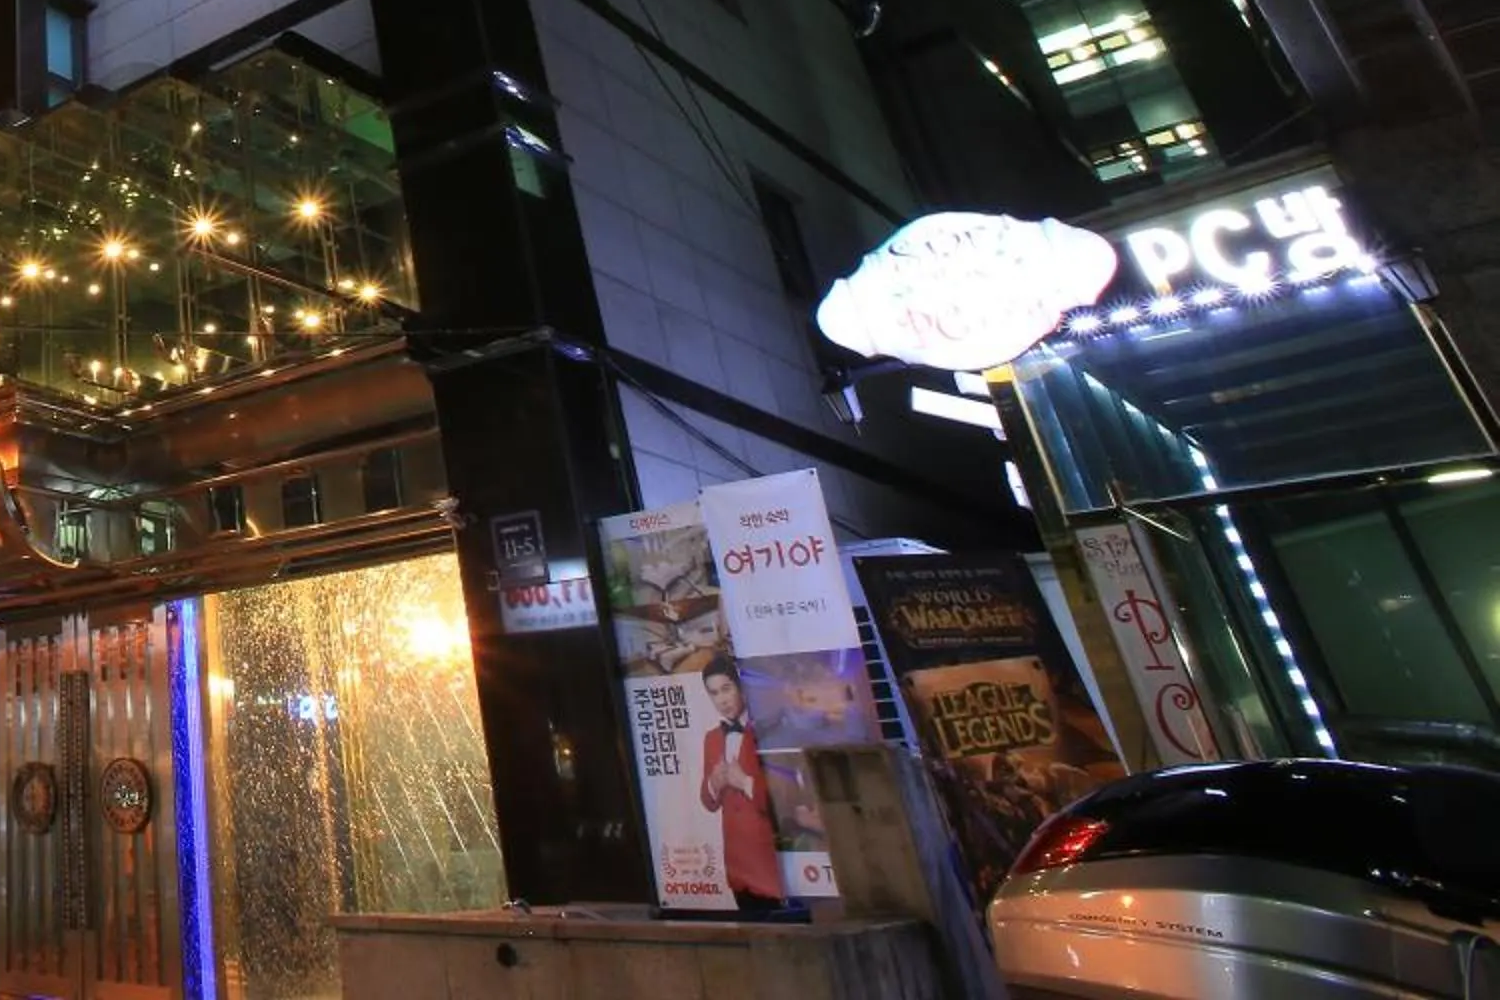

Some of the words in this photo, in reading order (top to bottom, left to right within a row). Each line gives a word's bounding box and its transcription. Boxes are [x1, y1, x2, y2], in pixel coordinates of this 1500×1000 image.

[766, 508, 790, 524] 숙박
[723, 535, 824, 574] 여기야
[634, 685, 687, 709] 주변에
[935, 681, 1025, 718] LEAGUE
[637, 708, 690, 731] 우리만
[933, 702, 1057, 759] LEGENDS
[644, 754, 681, 777] 없다
